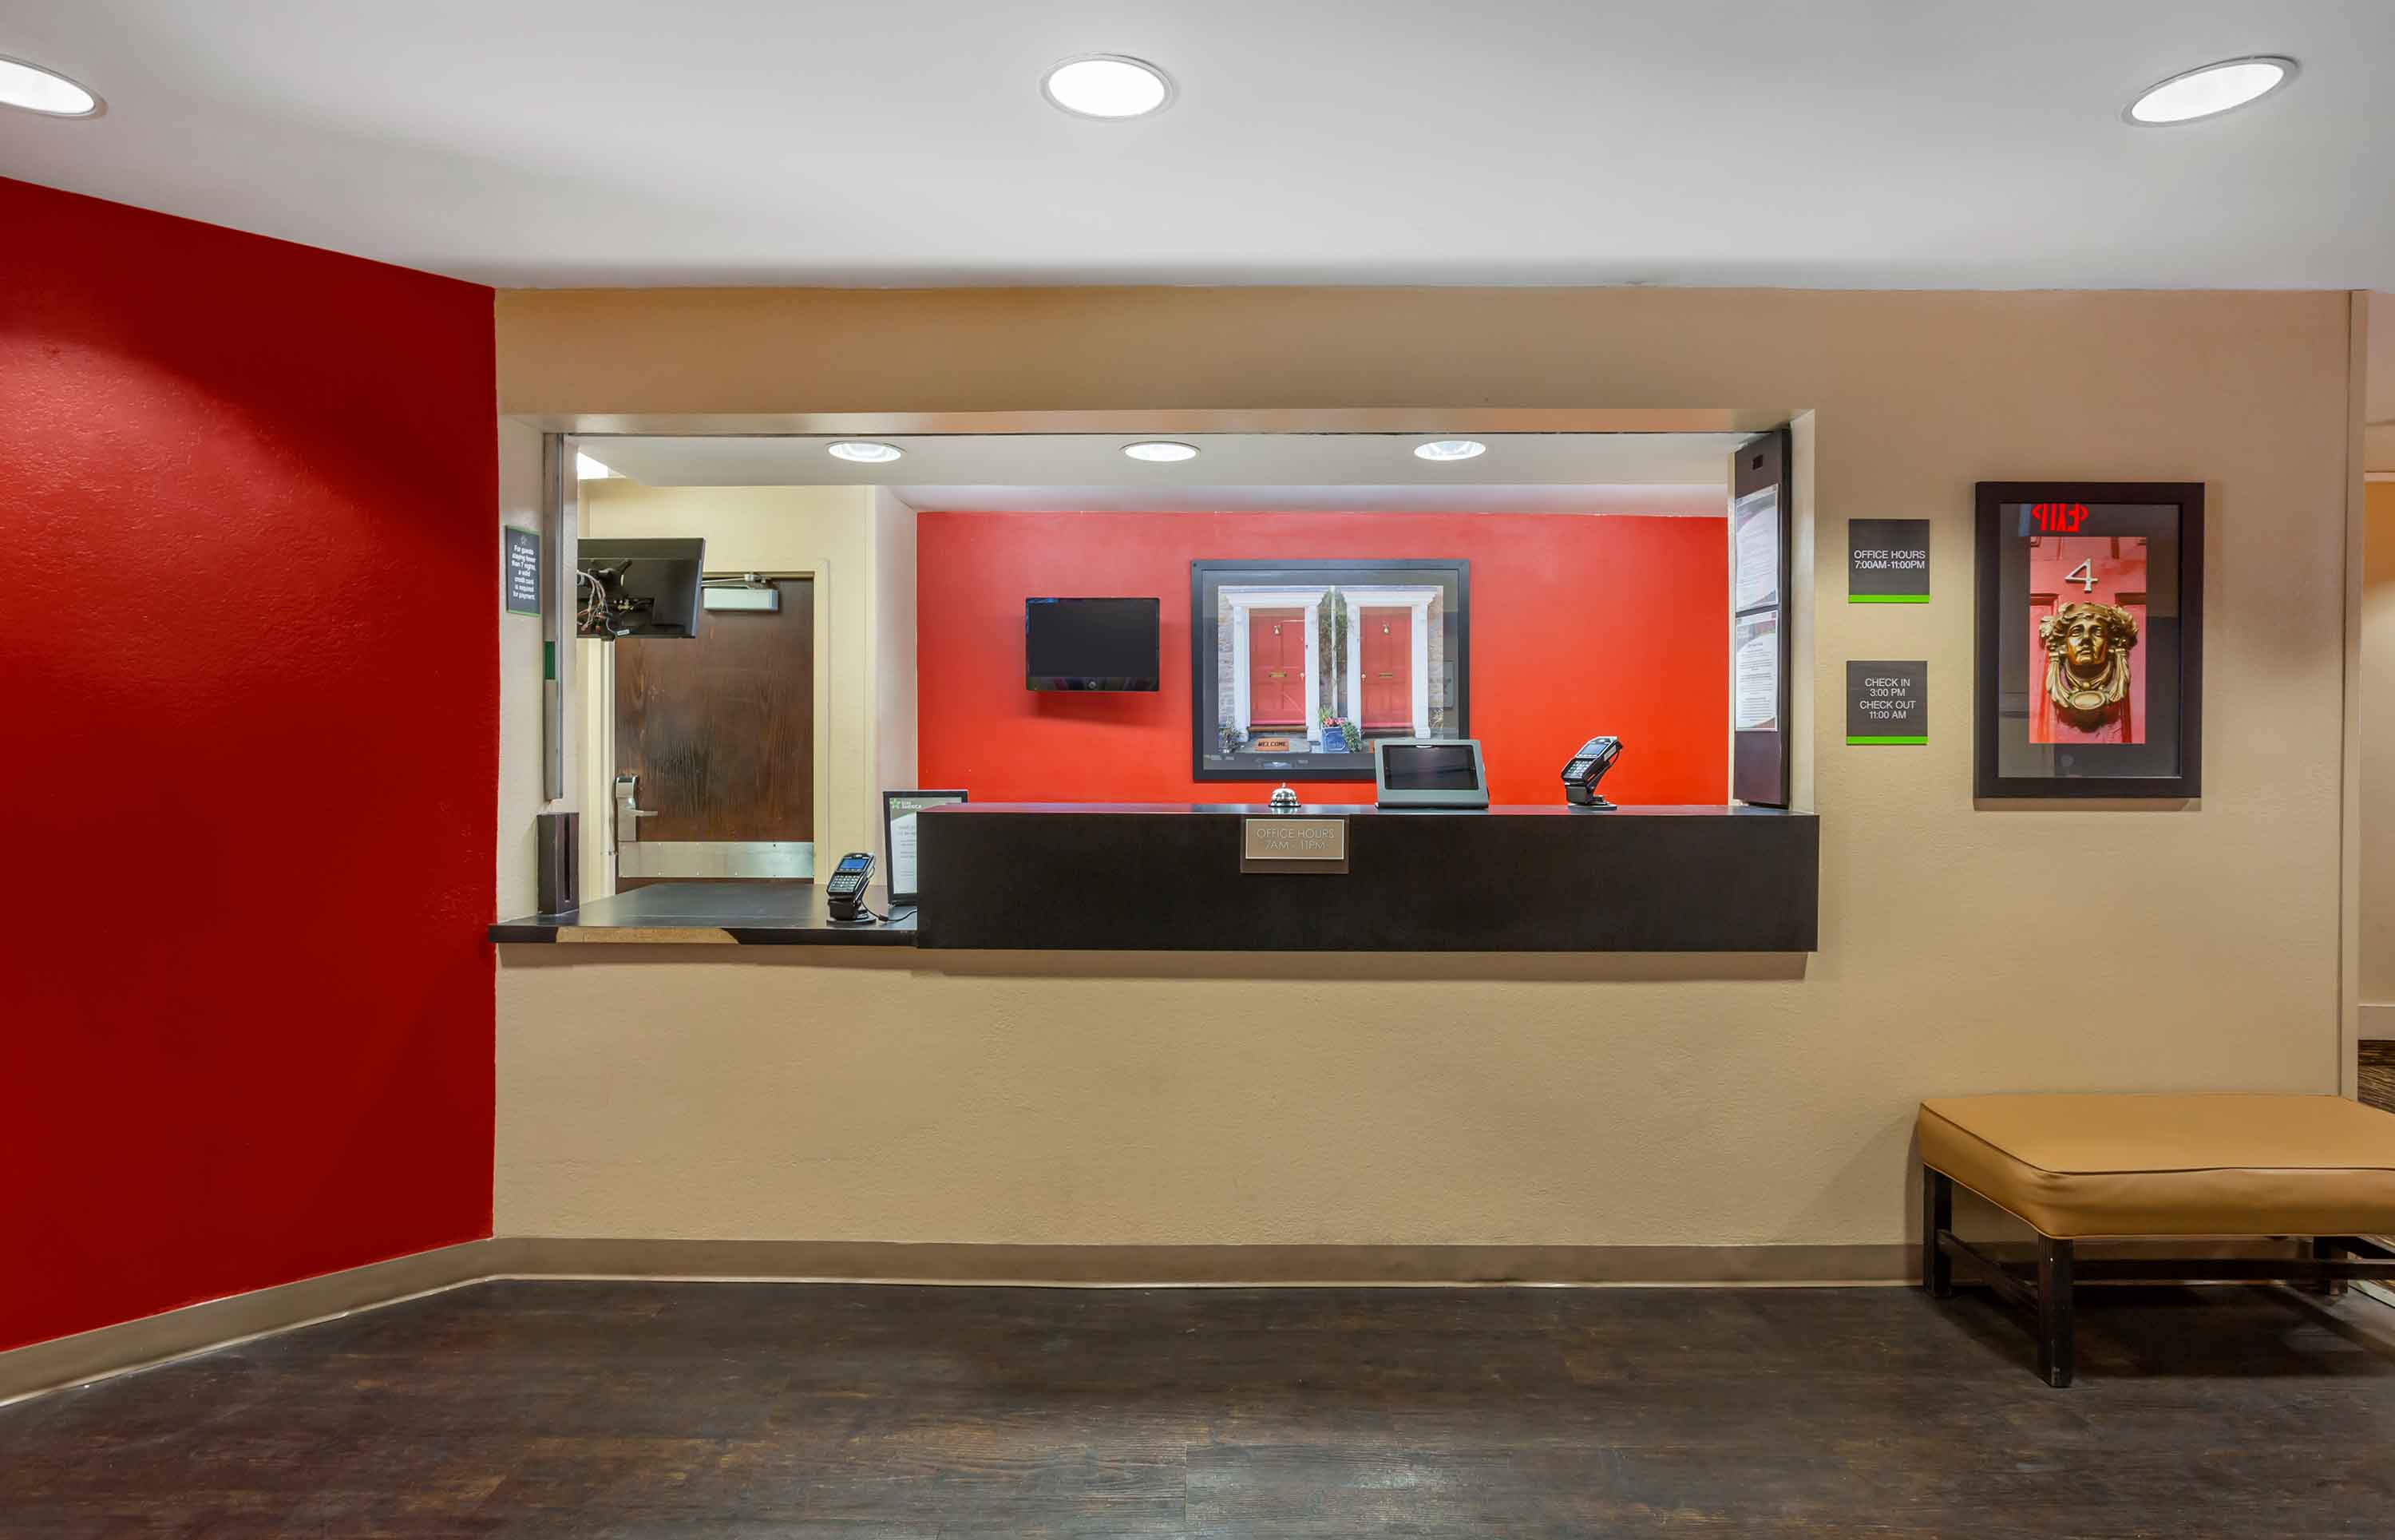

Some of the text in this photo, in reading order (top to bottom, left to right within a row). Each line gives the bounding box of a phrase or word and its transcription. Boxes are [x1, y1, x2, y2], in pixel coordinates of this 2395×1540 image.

[1854, 549, 1926, 559] OFFICE HOURS
[2064, 557, 2099, 592] 4
[1865, 678, 1910, 687] CHECK IN
[1870, 688, 1906, 697] 3:00 PM
[1859, 700, 1917, 710] CHECK OUT
[1869, 711, 1907, 719] 11:00 AM
[1257, 829, 1335, 838] OFFICE HOURS
[1265, 841, 1290, 850] 7AM
